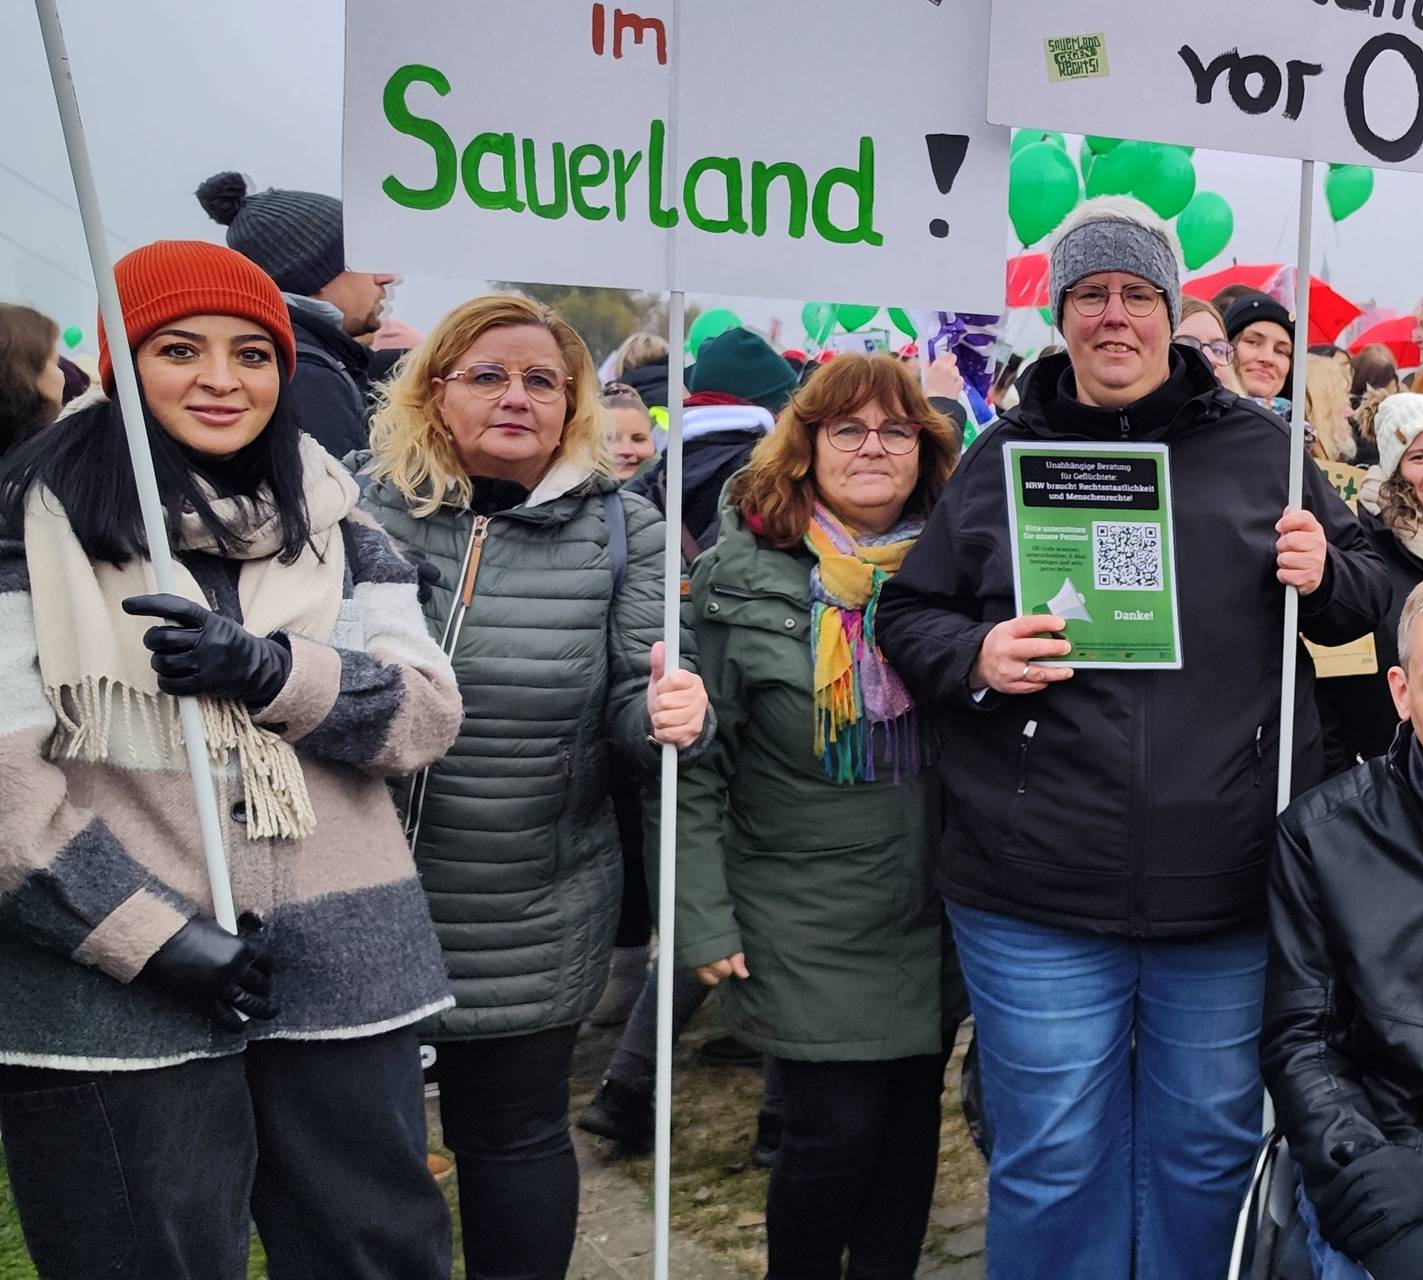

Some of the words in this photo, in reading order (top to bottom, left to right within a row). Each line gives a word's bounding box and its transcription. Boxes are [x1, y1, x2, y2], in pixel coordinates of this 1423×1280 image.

[1177, 45, 1324, 121] vor
[382, 64, 883, 246] Sauerland
[925, 134, 969, 238] !
[1045, 461, 1095, 471] Unabhängige
[1097, 463, 1131, 472] Beratung
[1060, 472, 1072, 480] für
[1025, 482, 1045, 490] NRW
[1046, 482, 1077, 491] braucht
[1079, 483, 1155, 493] Rechtsstaatlichkeit
[1066, 493, 1133, 502] Menschenrechte!
[1114, 610, 1154, 620] Danke!
